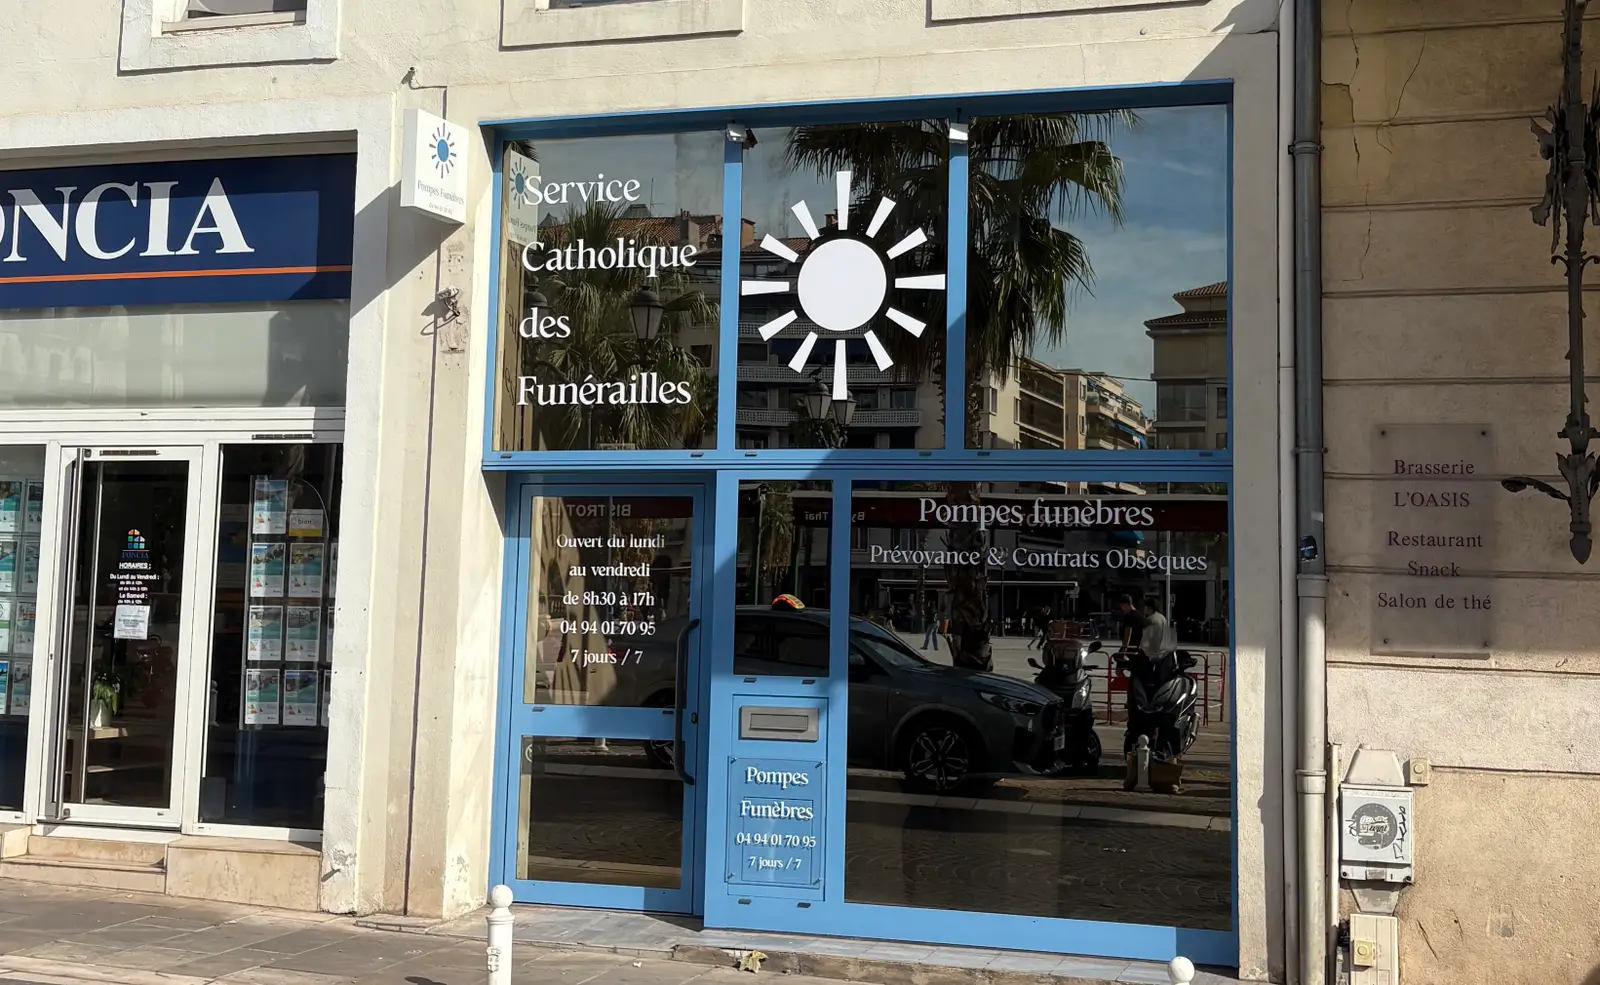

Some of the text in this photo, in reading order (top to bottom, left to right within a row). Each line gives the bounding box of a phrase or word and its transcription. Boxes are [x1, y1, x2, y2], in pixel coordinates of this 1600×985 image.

[524, 173, 641, 205] Service
[0, 176, 255, 262] NCIA
[522, 237, 697, 278] Catholique
[519, 307, 571, 338] des
[516, 372, 692, 407] Funérailles
[1394, 459, 1475, 475] Brasserie
[1393, 491, 1470, 507] L'OASIS
[919, 498, 1024, 531] Pompes
[1033, 497, 1155, 526] funèbres
[556, 534, 665, 548] Ouvert du lundi
[1387, 531, 1483, 547] Restaurant
[870, 544, 1208, 577] Prévoyance & Contrats Obsèques
[1407, 561, 1461, 577] Snack
[569, 562, 650, 577] au vendredi
[562, 591, 655, 606] de 8h30 à 17h
[1378, 592, 1492, 609] Salon de thé
[560, 620, 656, 635] 04 94 01 70 95
[570, 649, 643, 667] 7 jours / 7
[746, 766, 809, 788] Pompes
[741, 800, 814, 819] Funèbres
[736, 832, 816, 848] 04 94 01 70 95
[750, 856, 802, 870] 7 jours / 7
